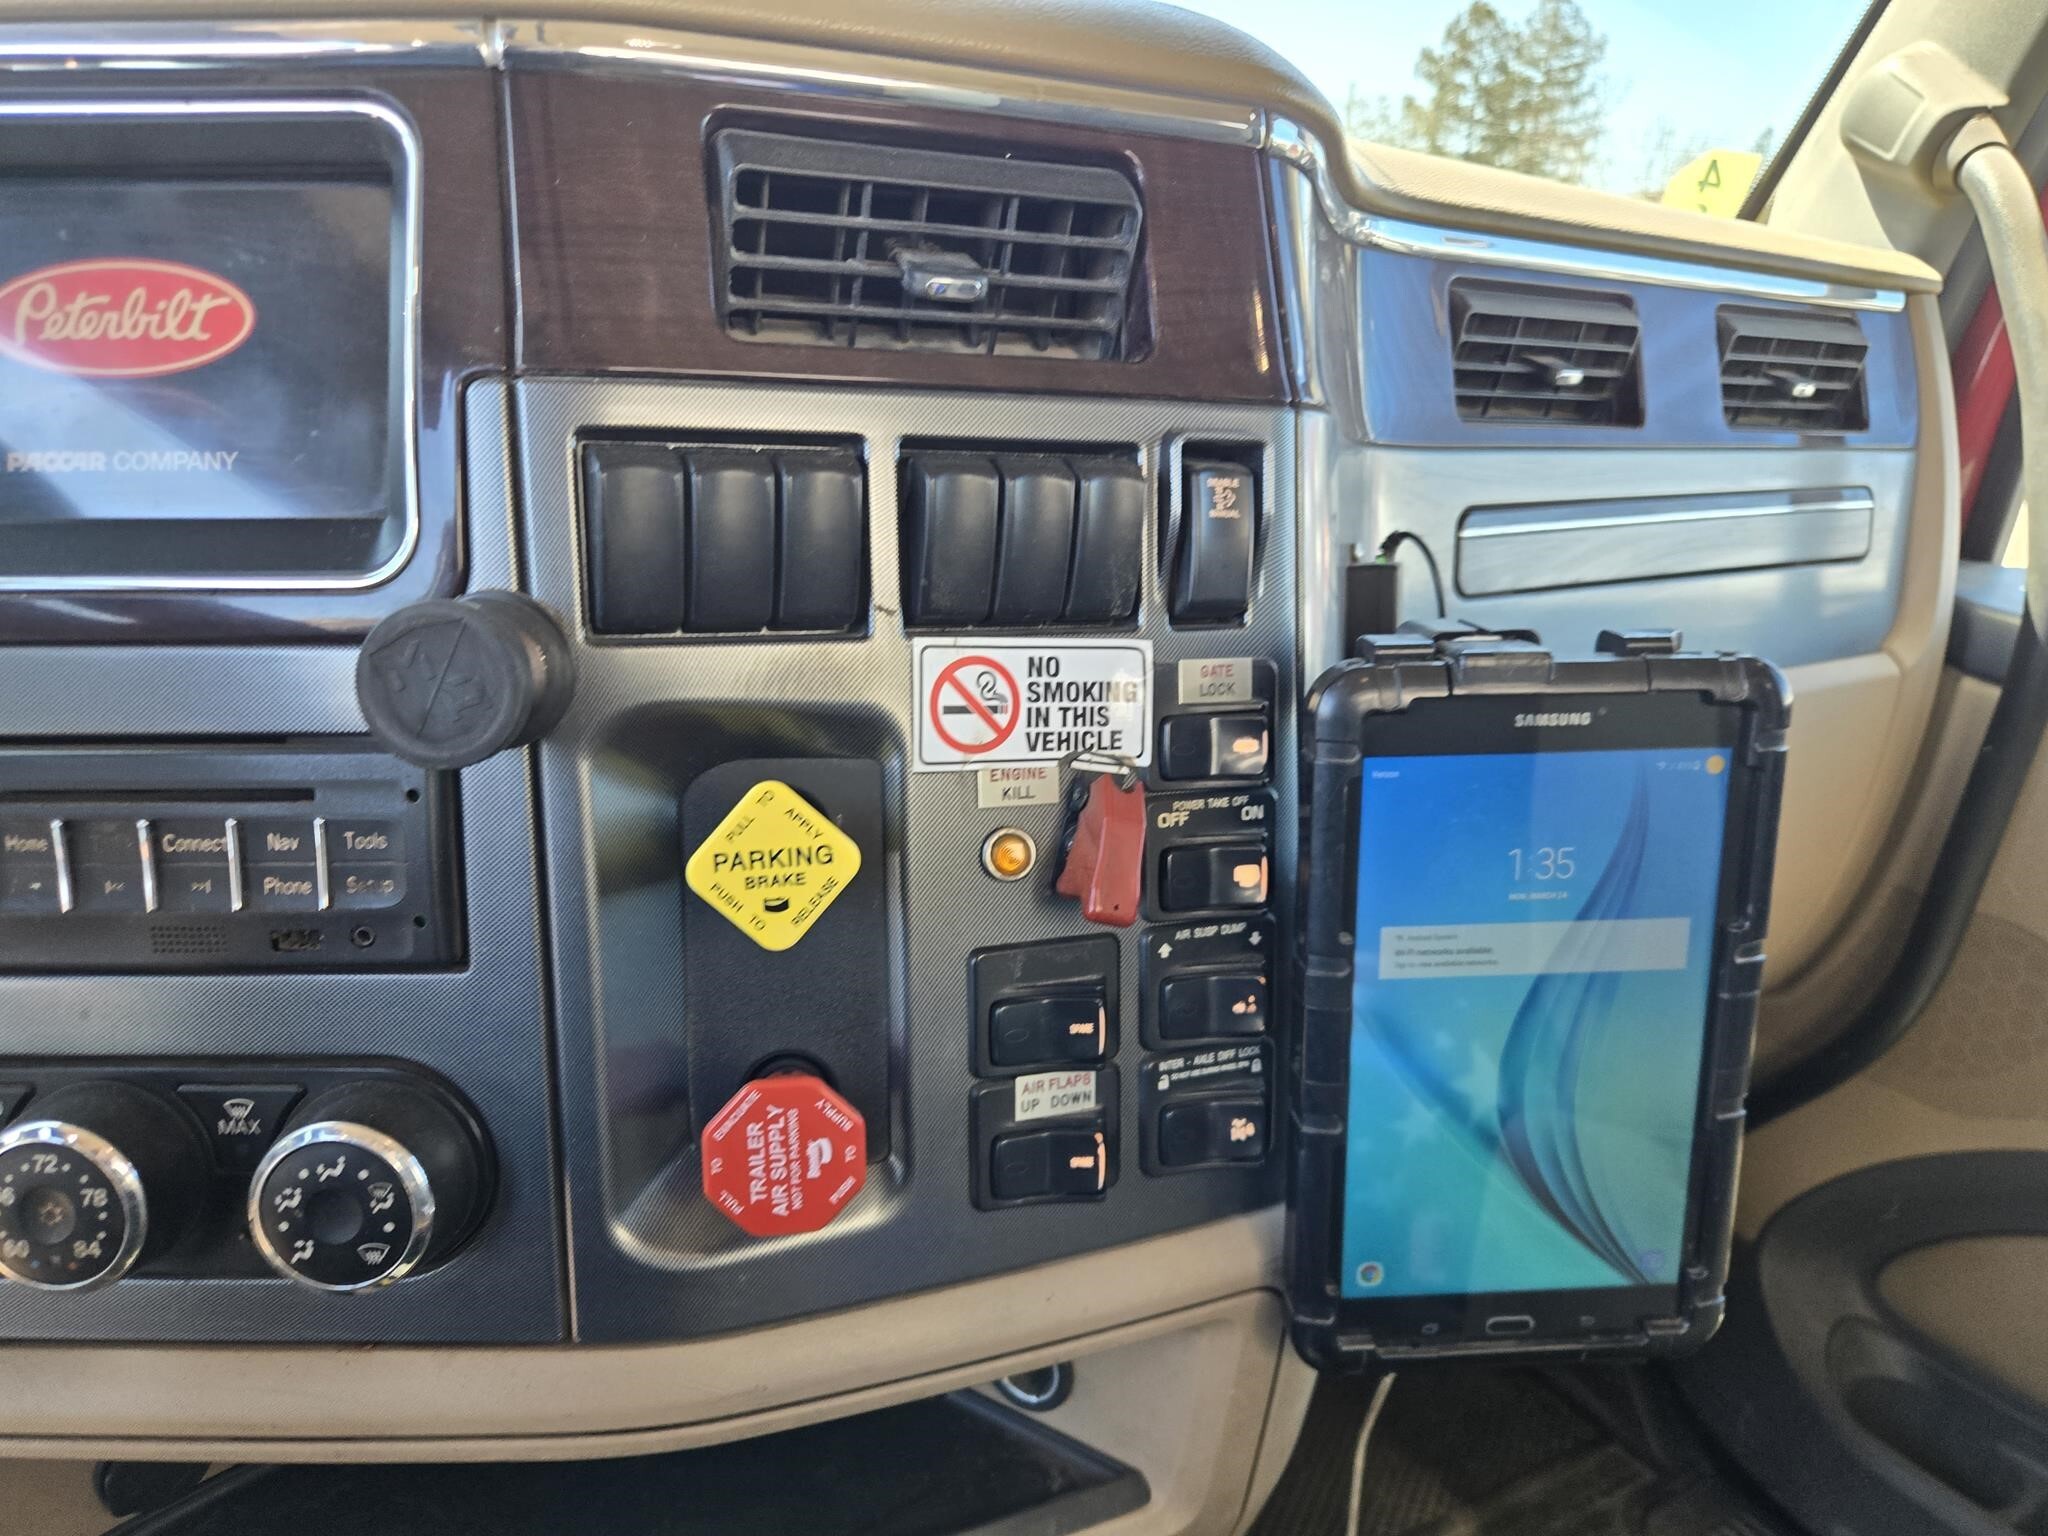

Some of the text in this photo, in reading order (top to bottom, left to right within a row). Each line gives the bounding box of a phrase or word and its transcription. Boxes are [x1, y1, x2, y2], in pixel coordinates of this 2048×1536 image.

[15, 282, 231, 347] Peterbilt
[112, 451, 239, 473] COMPANY
[1027, 656, 1060, 678] NO
[1200, 664, 1234, 679] GATE
[1026, 681, 1138, 704] SMOKING
[1200, 682, 1236, 697] LOCK
[1026, 706, 1110, 728] IN THIS
[1514, 712, 1591, 727] SAMSUNG
[1025, 730, 1123, 752] VEHICLE
[989, 767, 1049, 783] ENGINE
[1001, 785, 1036, 801] KILL
[1231, 794, 1250, 807] OFF
[1157, 810, 1190, 829] OFF
[1241, 804, 1264, 821] ON
[725, 816, 756, 842] PULL
[784, 808, 824, 839] APPLY
[4, 834, 48, 851] Home
[267, 832, 300, 851] Nav
[343, 831, 388, 850] Tools
[713, 845, 834, 873] PARKING
[1508, 847, 1575, 880] 1:35
[264, 876, 313, 896] Phone
[744, 872, 807, 890] BRAKE
[710, 876, 839, 931] PUSH TO RELEASE
[1238, 1045, 1261, 1058] LOCK
[1021, 1072, 1092, 1096] AIR FLAPS
[1021, 1090, 1092, 1114] UP DOWN
[217, 1119, 261, 1135] MAX
[31, 1154, 58, 1174] 72
[710, 1157, 724, 1176] TO
[746, 1121, 768, 1205] TRAILER
[766, 1104, 789, 1217] AIR SUPPLY
[80, 1188, 108, 1208] 78
[73, 1240, 102, 1259] 84
